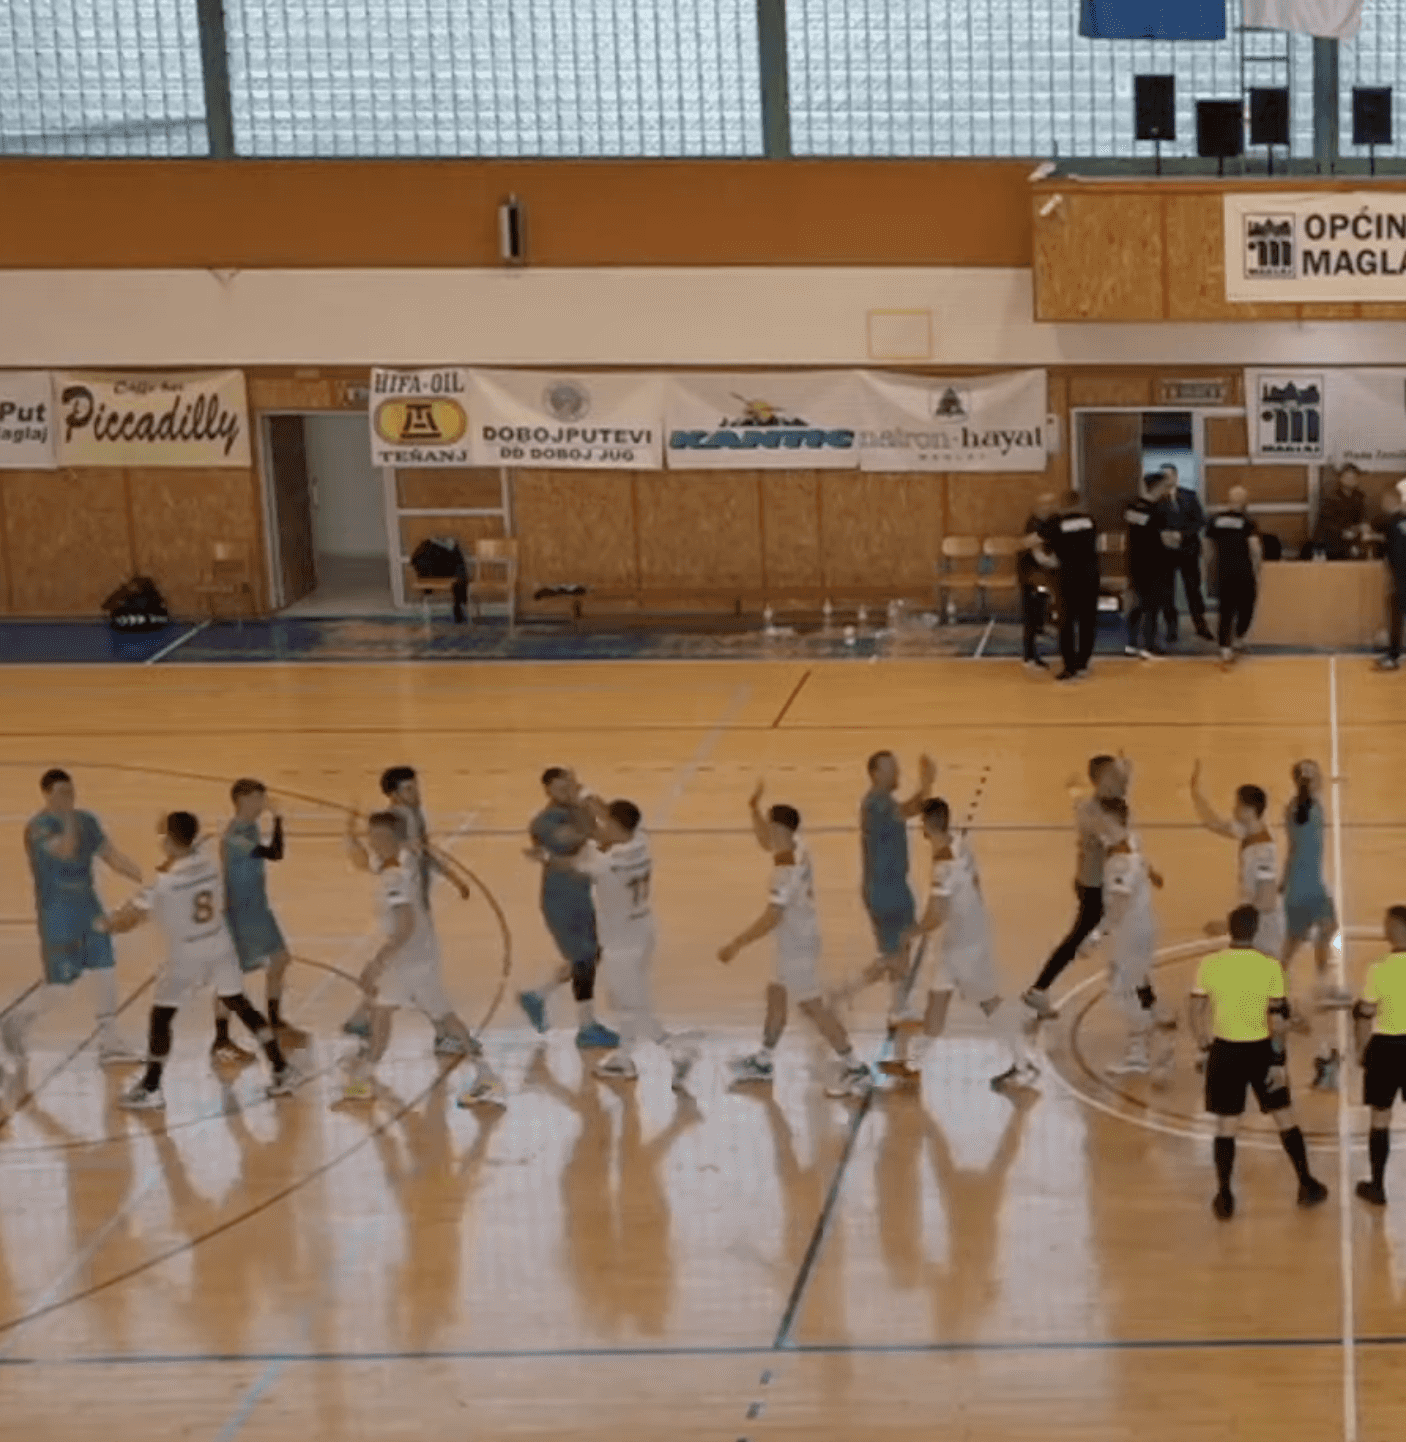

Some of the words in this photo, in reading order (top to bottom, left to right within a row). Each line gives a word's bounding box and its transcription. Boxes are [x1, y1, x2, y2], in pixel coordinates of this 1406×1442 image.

[374, 371, 464, 394] HIFA-OIL
[0, 401, 47, 423] Put
[61, 385, 239, 456] Piccadilly
[0, 427, 48, 444] aglaj
[482, 426, 652, 444] DOBOJPUTEVI
[531, 449, 592, 461] DOBOJ
[599, 449, 635, 462] JUG
[191, 890, 214, 924] 8
